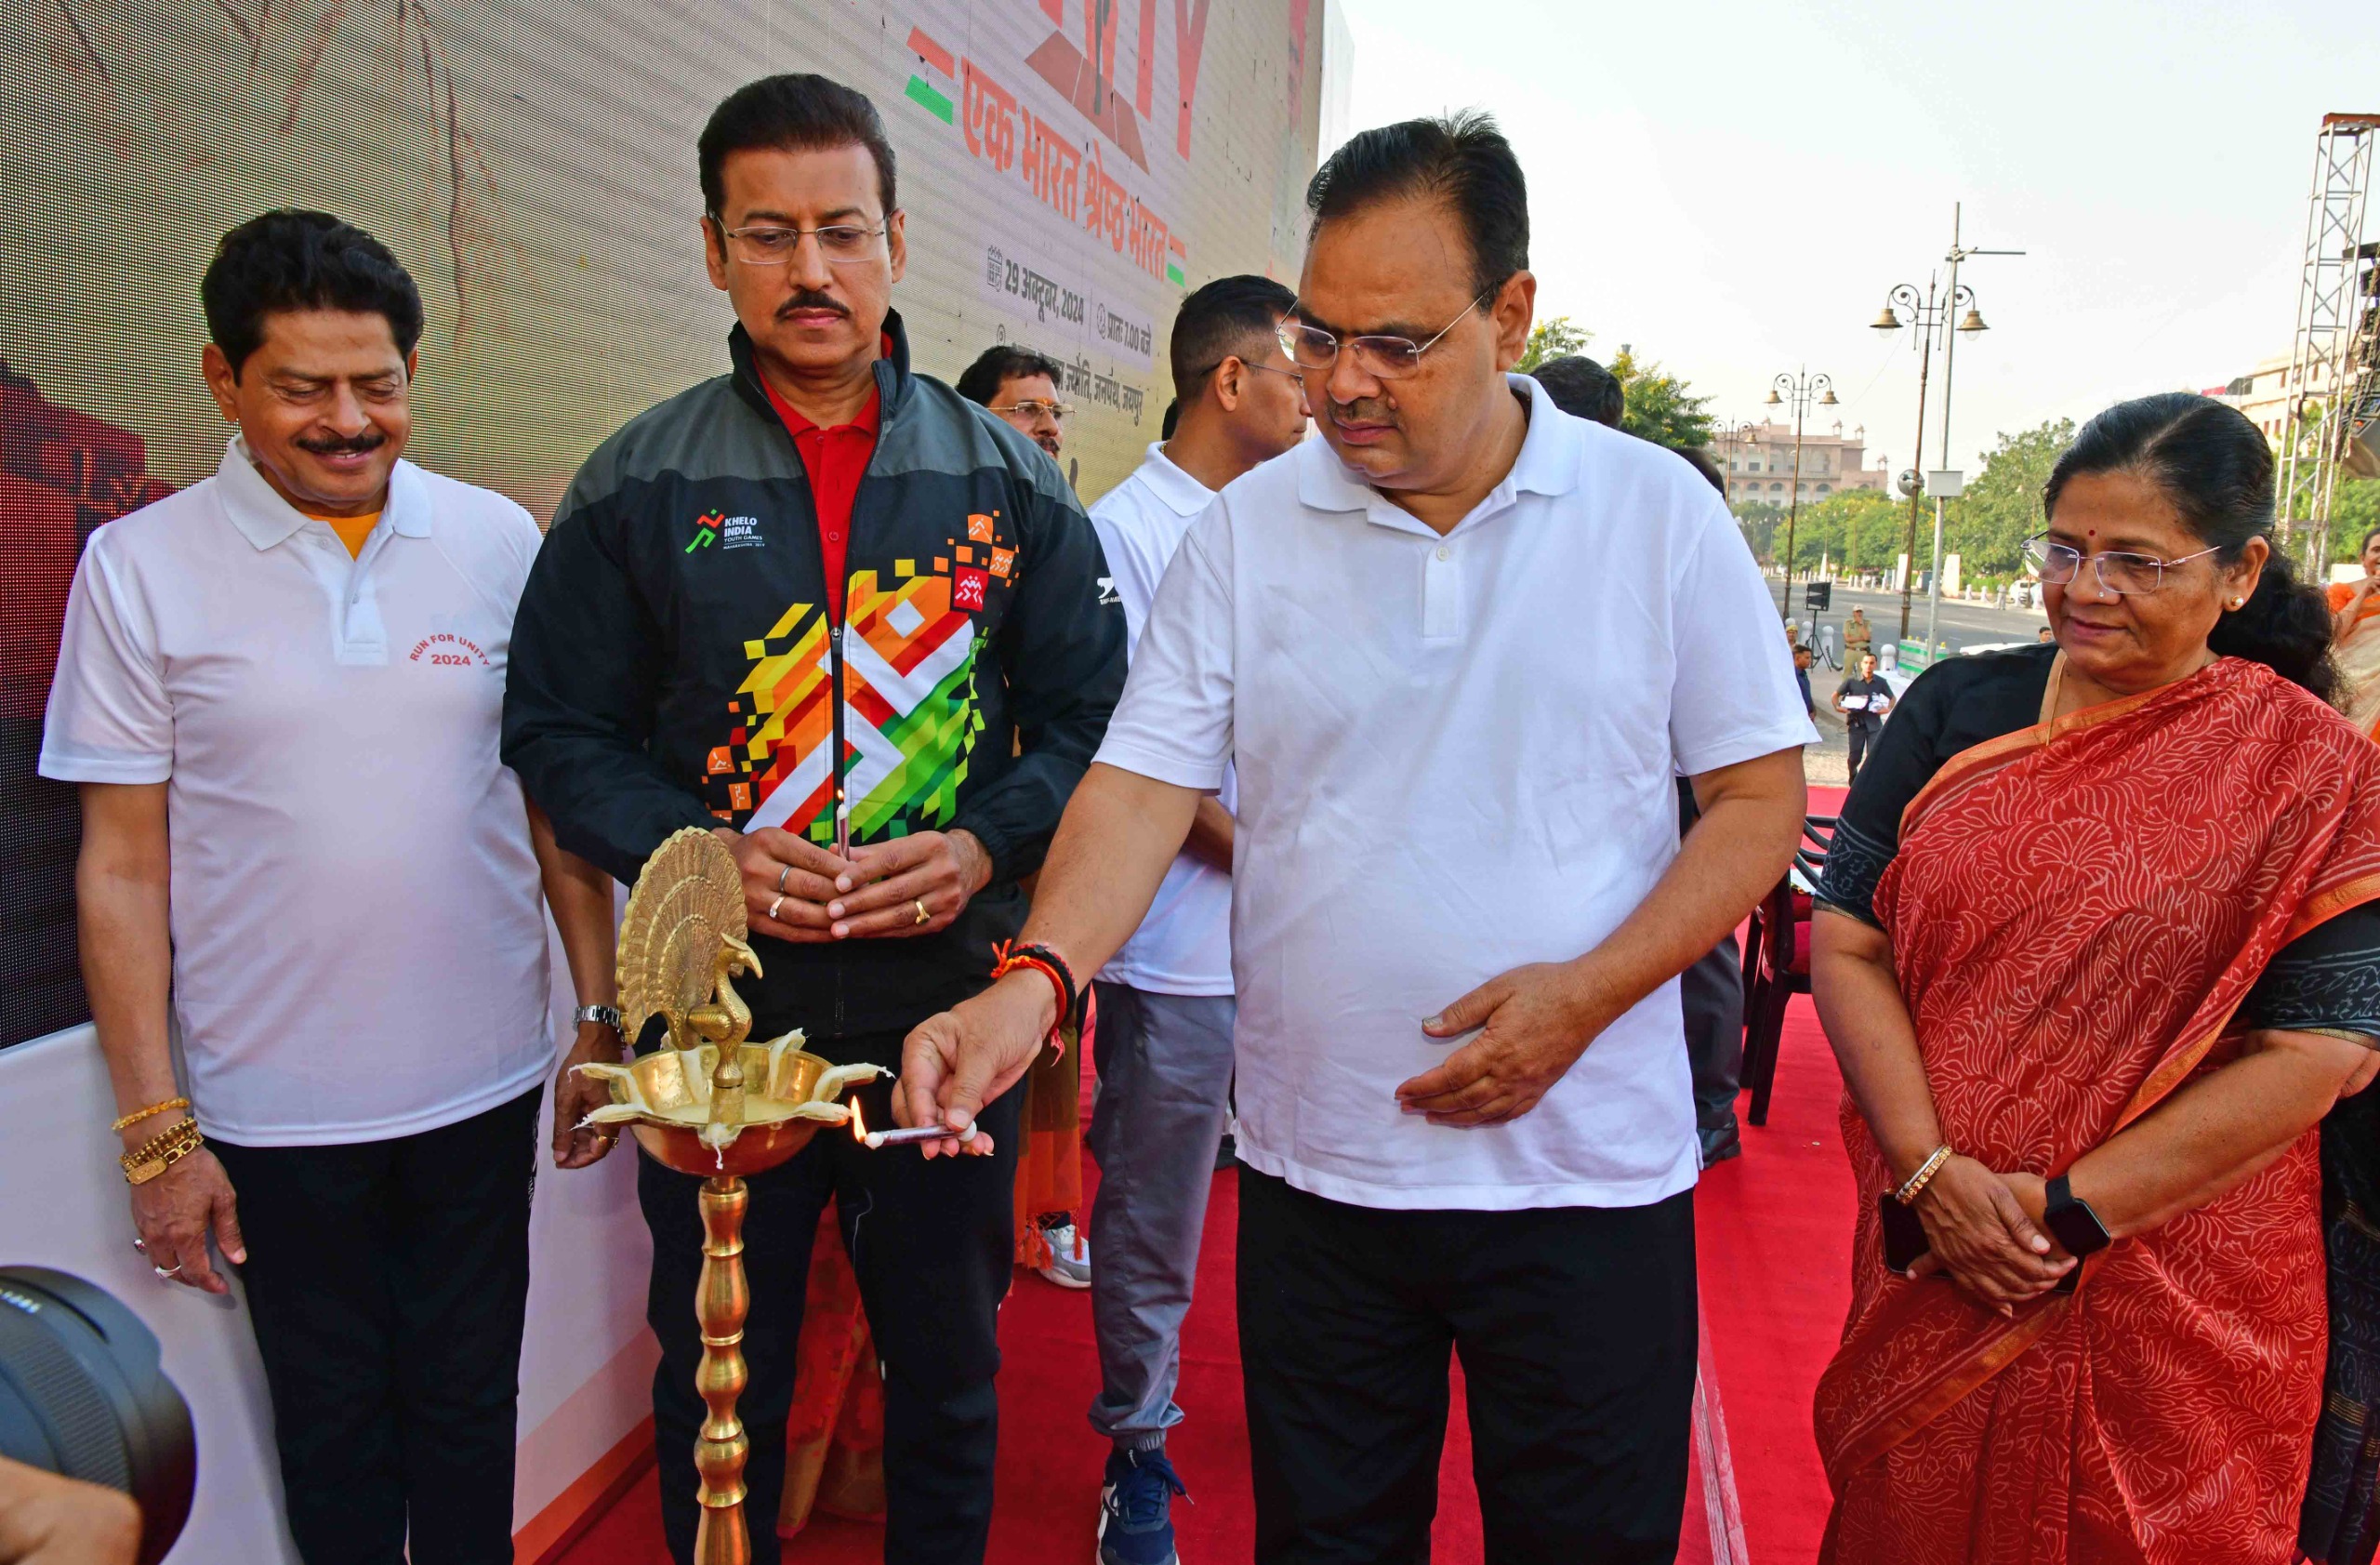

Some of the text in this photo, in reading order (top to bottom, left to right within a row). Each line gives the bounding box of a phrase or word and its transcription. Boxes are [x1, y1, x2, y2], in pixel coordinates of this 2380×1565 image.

[961, 56, 1017, 174] एक
[1022, 105, 1081, 222] भारत
[1129, 195, 1169, 283] भारत
[1005, 259, 1020, 295] 29
[1061, 288, 1084, 325] 2024
[1140, 323, 1151, 357] बजे
[1094, 374, 1120, 413] जनपथ,
[1122, 384, 1144, 427] जयपुर
[724, 516, 758, 527] KHELO
[724, 525, 752, 537] INDIA
[409, 633, 490, 666] RUN FOR UNITY
[430, 654, 471, 667] 2024
